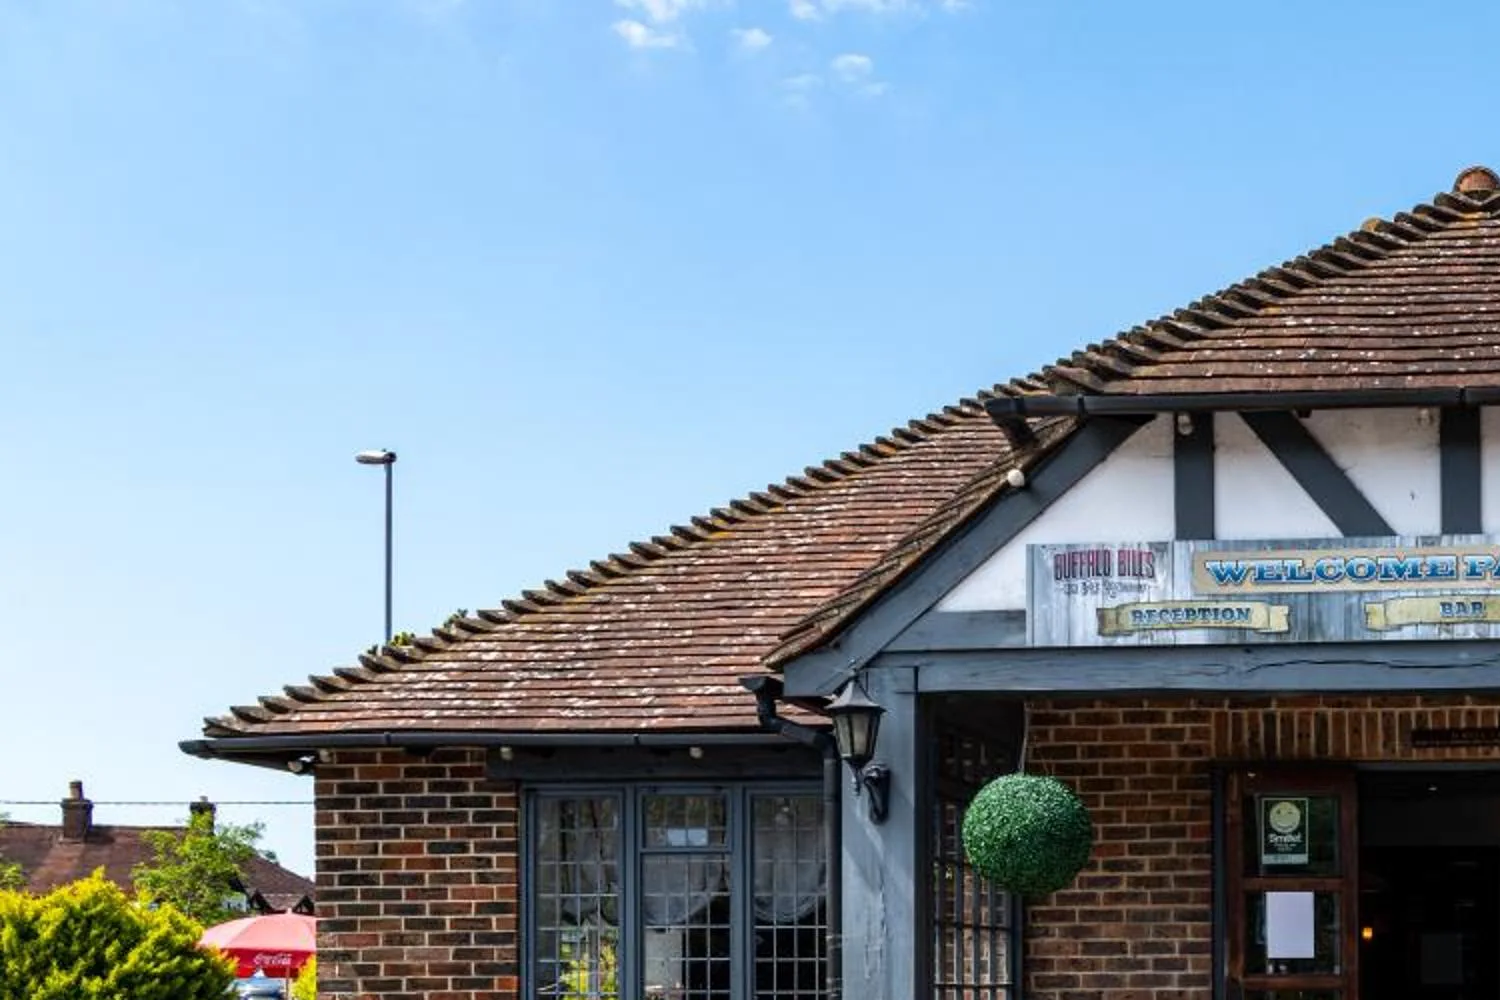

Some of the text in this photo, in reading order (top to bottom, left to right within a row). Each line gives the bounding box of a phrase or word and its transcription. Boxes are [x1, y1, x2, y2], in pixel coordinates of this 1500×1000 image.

[1054, 549, 1111, 581] BUFFALO
[1205, 555, 1458, 586] WELCOME
[1131, 607, 1251, 624] RECEPTION
[1440, 601, 1487, 618] BAR
